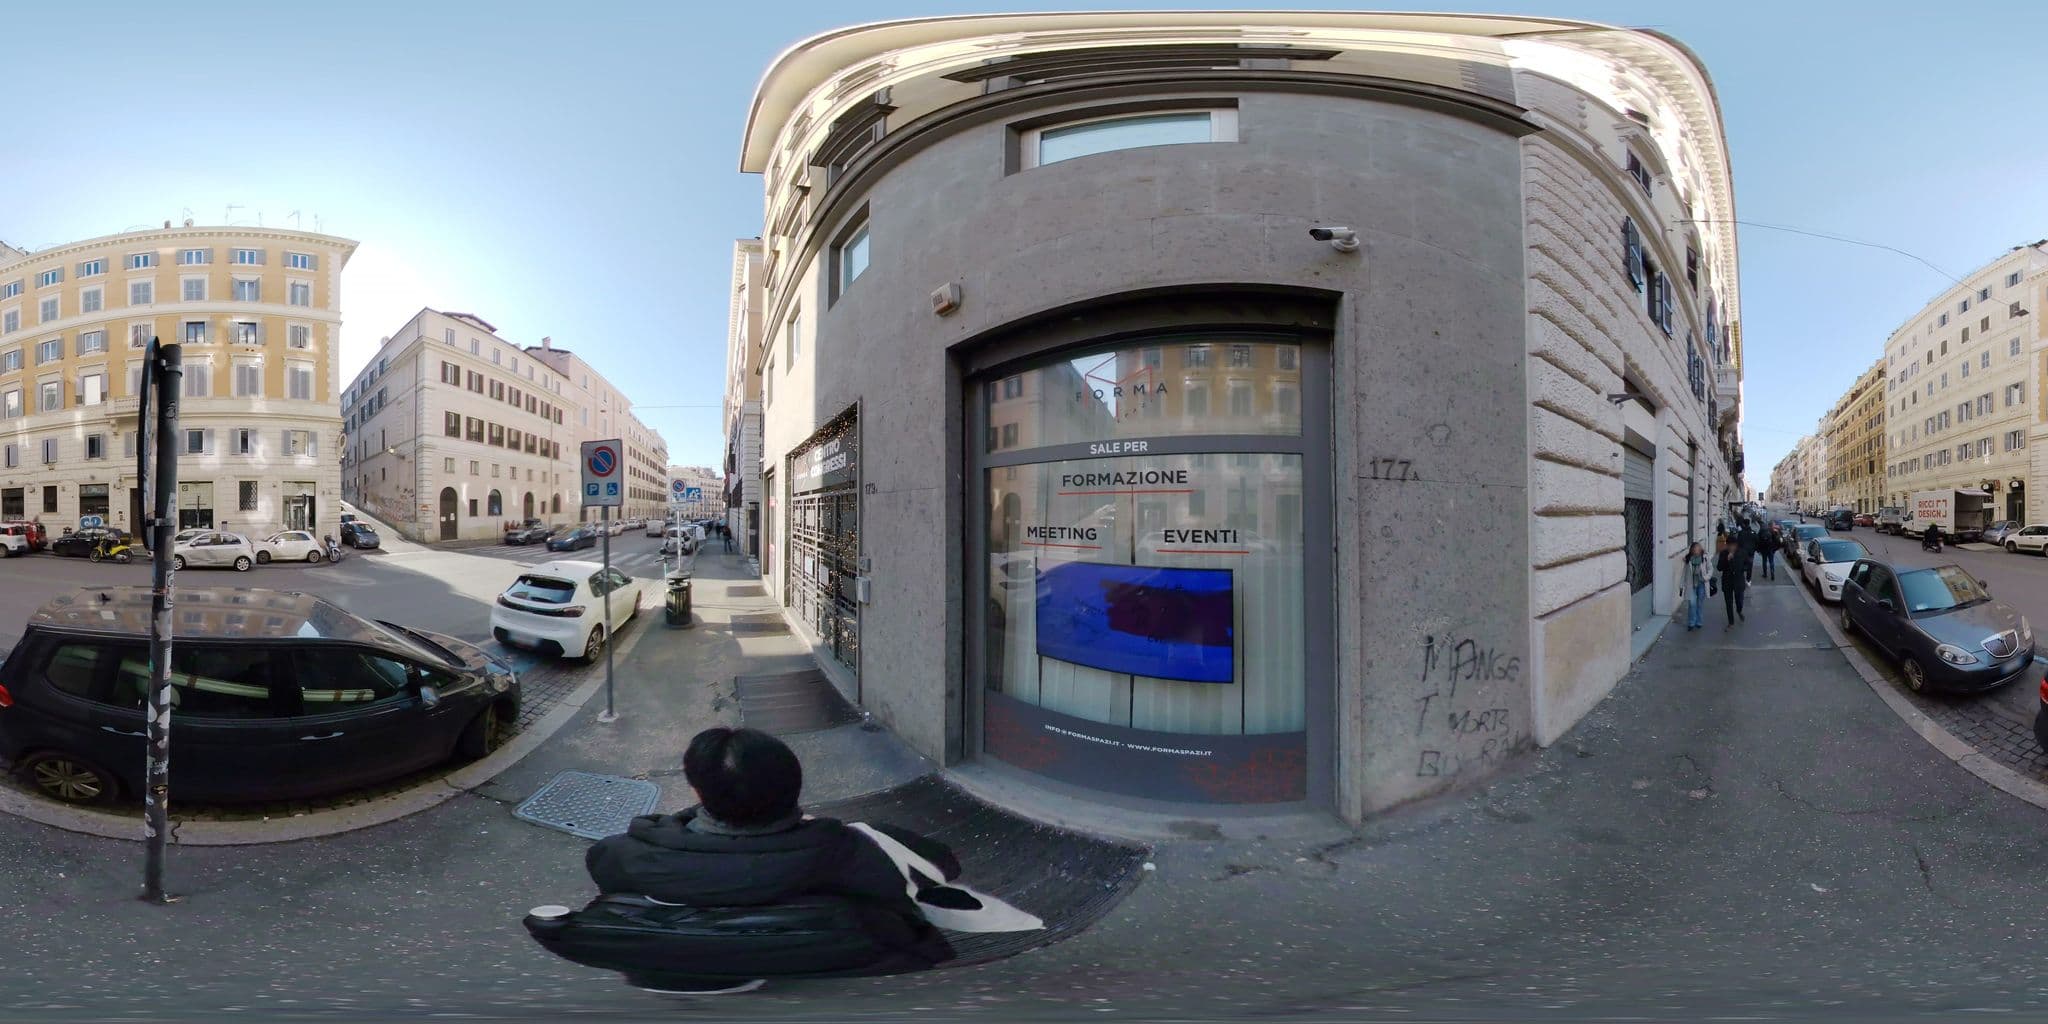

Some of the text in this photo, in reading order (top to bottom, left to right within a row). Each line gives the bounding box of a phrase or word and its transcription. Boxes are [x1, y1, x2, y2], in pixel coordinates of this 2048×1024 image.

[1076, 382, 1168, 402] FORMA
[1090, 441, 1148, 454] SALE PER
[1062, 470, 1188, 487] FORMAZIONE
[1918, 500, 1934, 509] RICCI
[1918, 510, 1941, 518] DESIGN
[1027, 526, 1097, 541] MEETING
[1164, 529, 1237, 543] EVENTI
